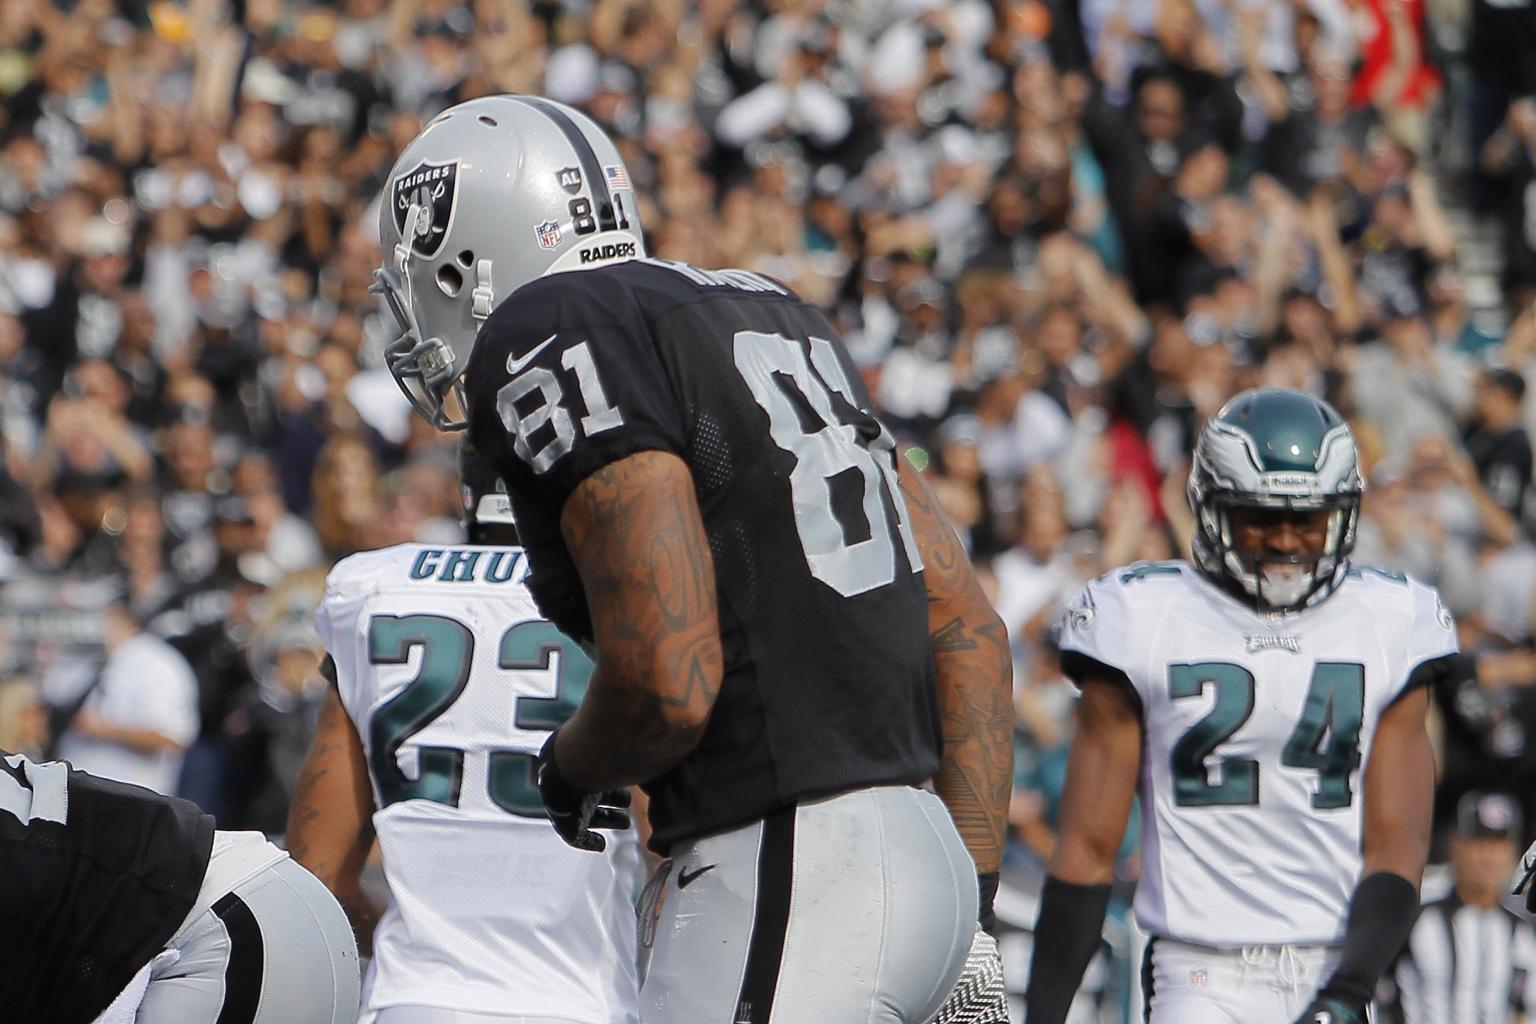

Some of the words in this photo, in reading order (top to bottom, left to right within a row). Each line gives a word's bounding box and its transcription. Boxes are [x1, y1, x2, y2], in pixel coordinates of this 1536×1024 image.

[397, 165, 450, 192] RAIDERS
[560, 170, 581, 187] AL
[567, 192, 629, 236] 81
[539, 231, 562, 248] NFL
[579, 242, 637, 264] RAIDERS
[496, 340, 625, 475] 81
[409, 548, 531, 584] CHU
[368, 614, 598, 819] 23
[1168, 662, 1365, 809] 24
